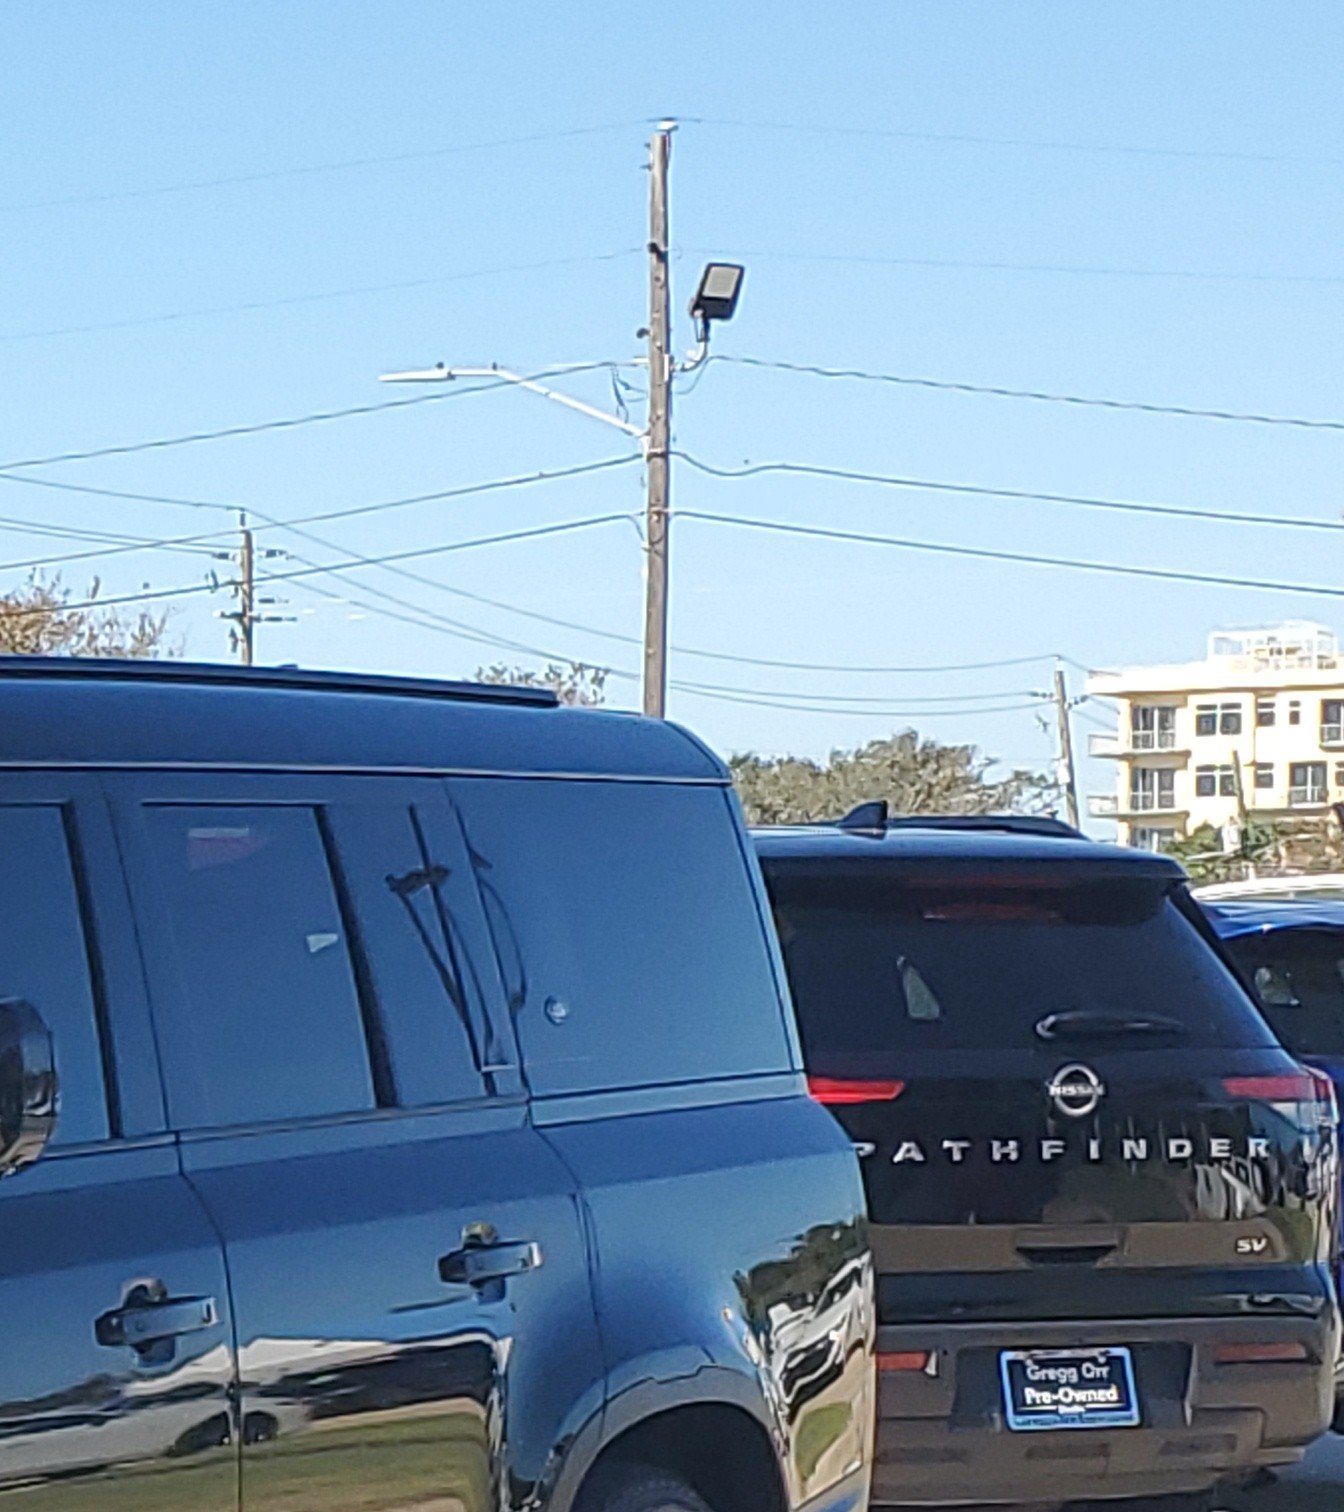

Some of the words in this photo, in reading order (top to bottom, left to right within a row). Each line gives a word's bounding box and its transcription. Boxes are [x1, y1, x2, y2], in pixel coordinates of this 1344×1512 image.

[852, 1137, 1271, 1163] PATHFINDER
[1237, 1238, 1268, 1252] SV
[1026, 1364, 1079, 1384] Gregg
[1081, 1362, 1110, 1379] Orr
[1024, 1384, 1119, 1404] Pre-Owned
